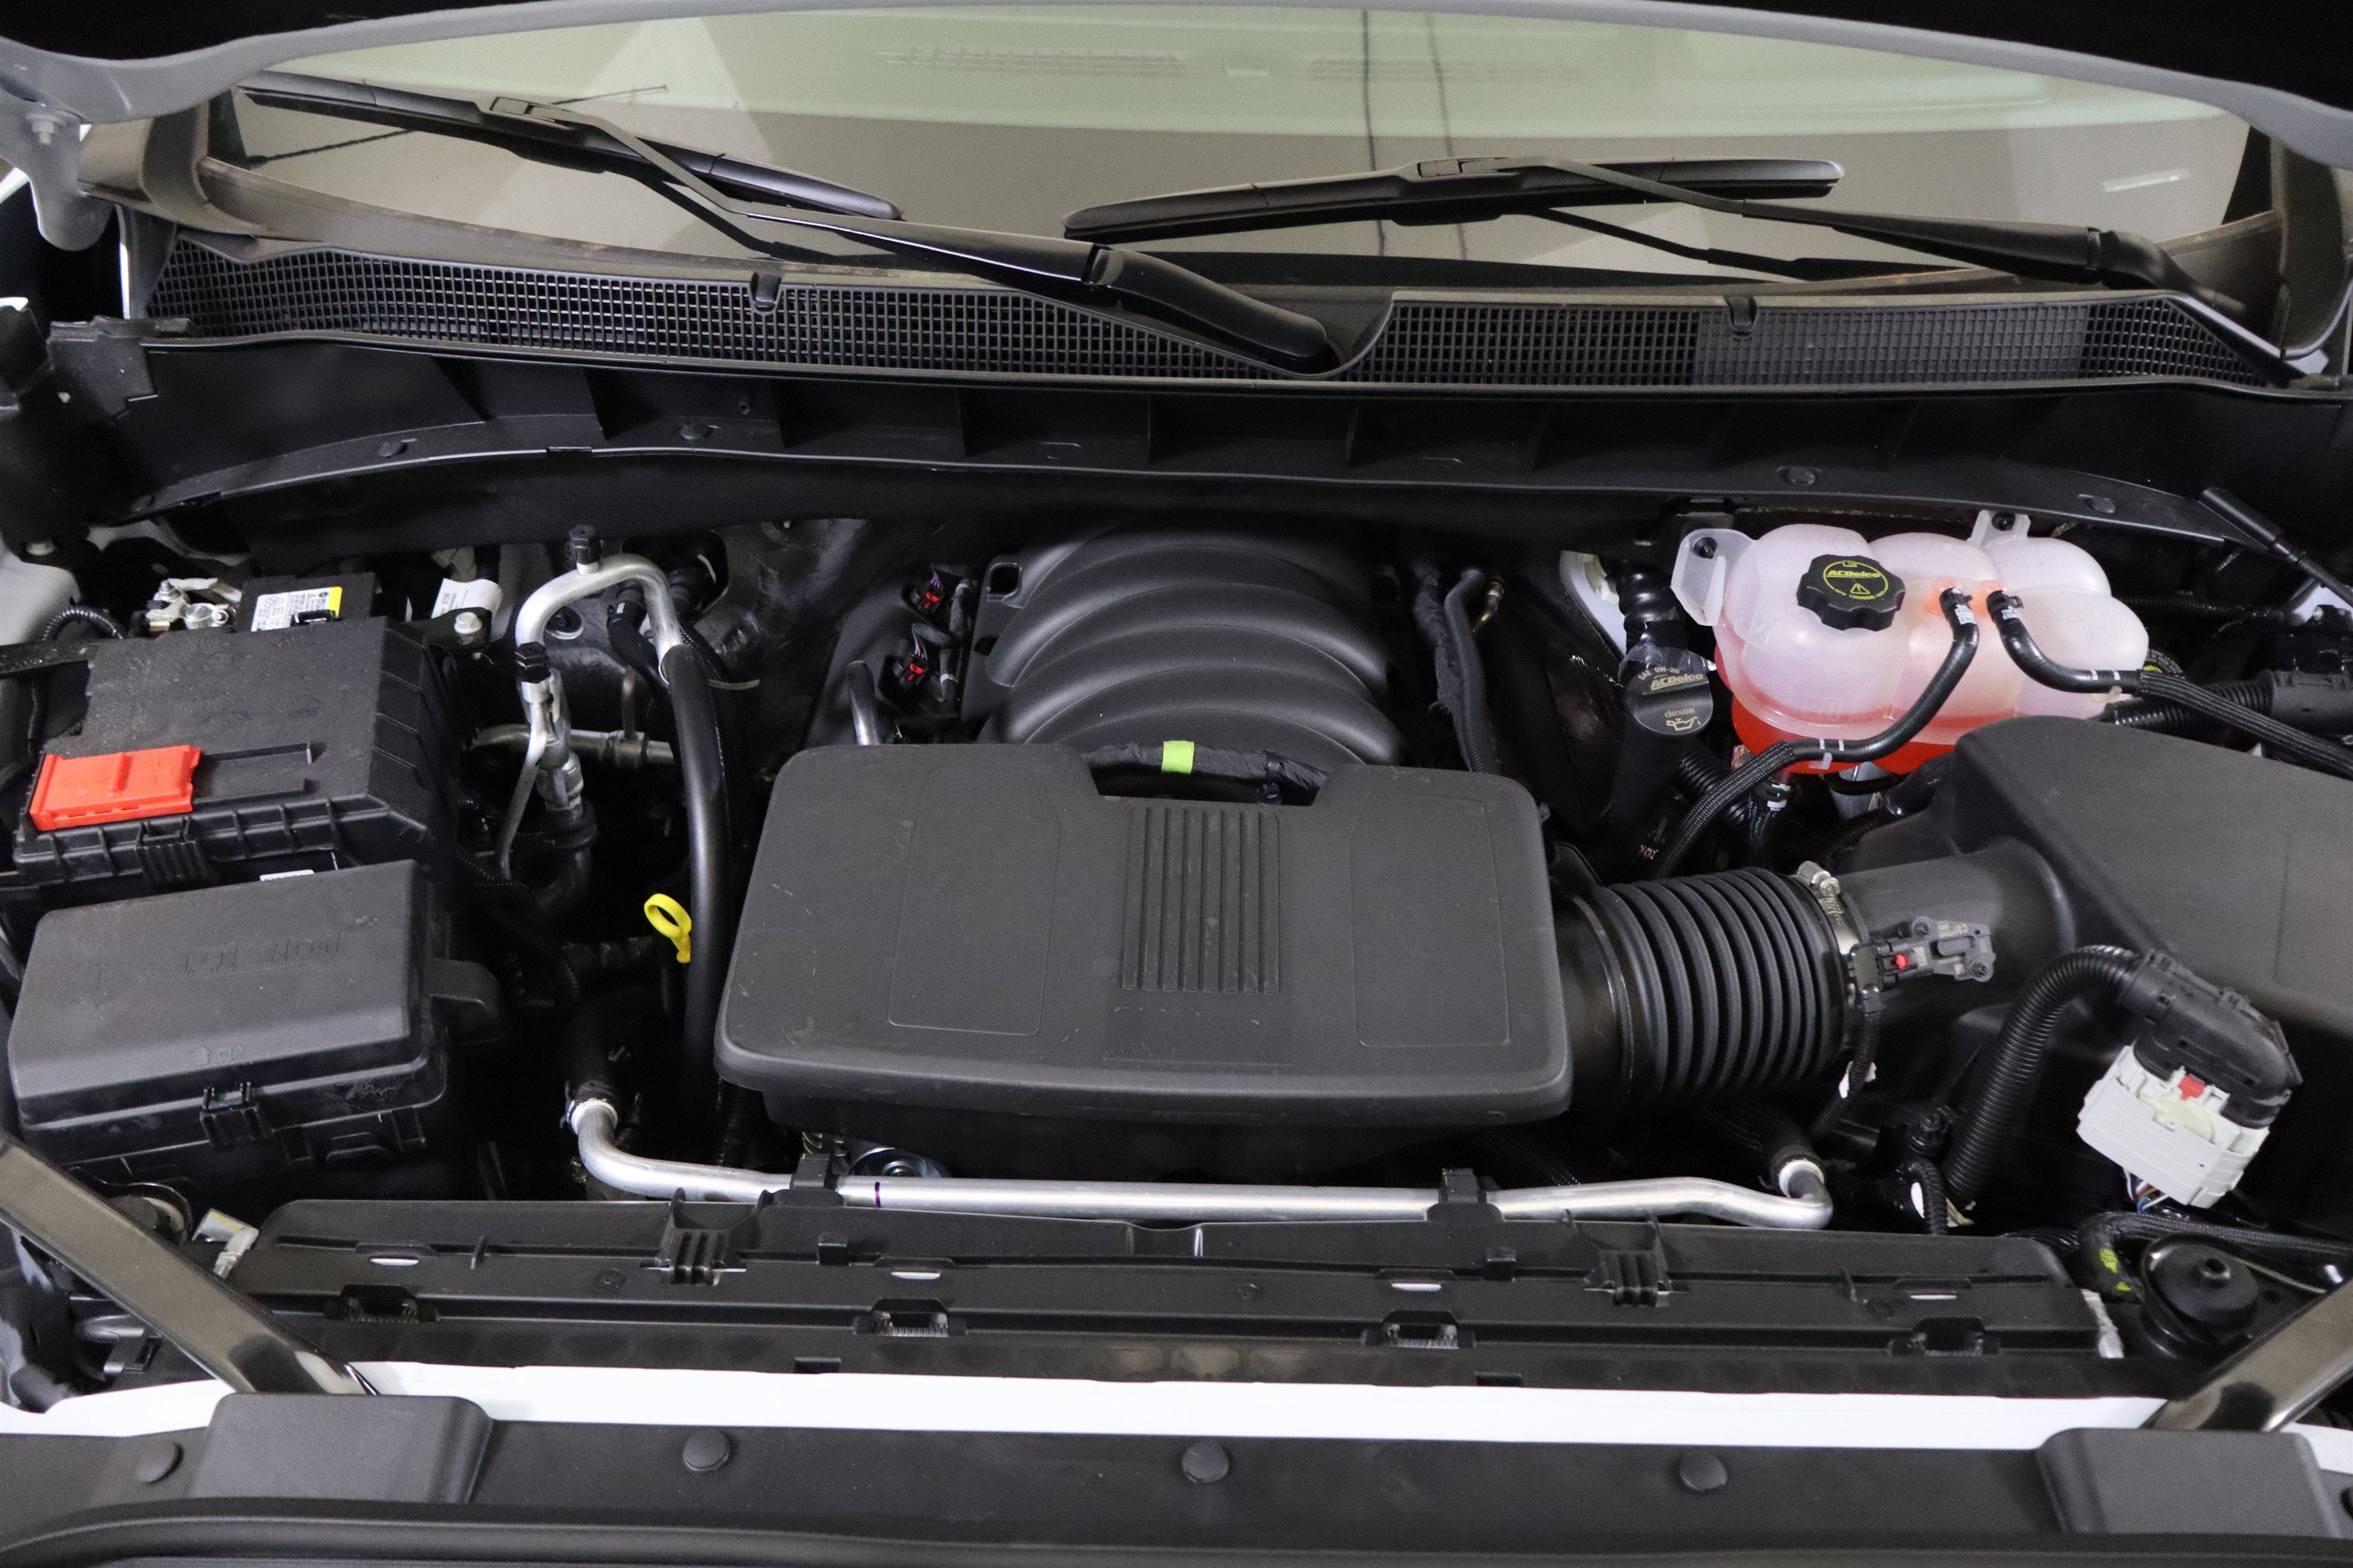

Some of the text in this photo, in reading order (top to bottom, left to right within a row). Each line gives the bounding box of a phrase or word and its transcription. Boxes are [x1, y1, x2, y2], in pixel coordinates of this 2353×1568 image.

[1638, 666, 1680, 681] SAE 0W-20
[1650, 674, 1704, 689] ACDelco
[1665, 708, 1695, 717] dexos
